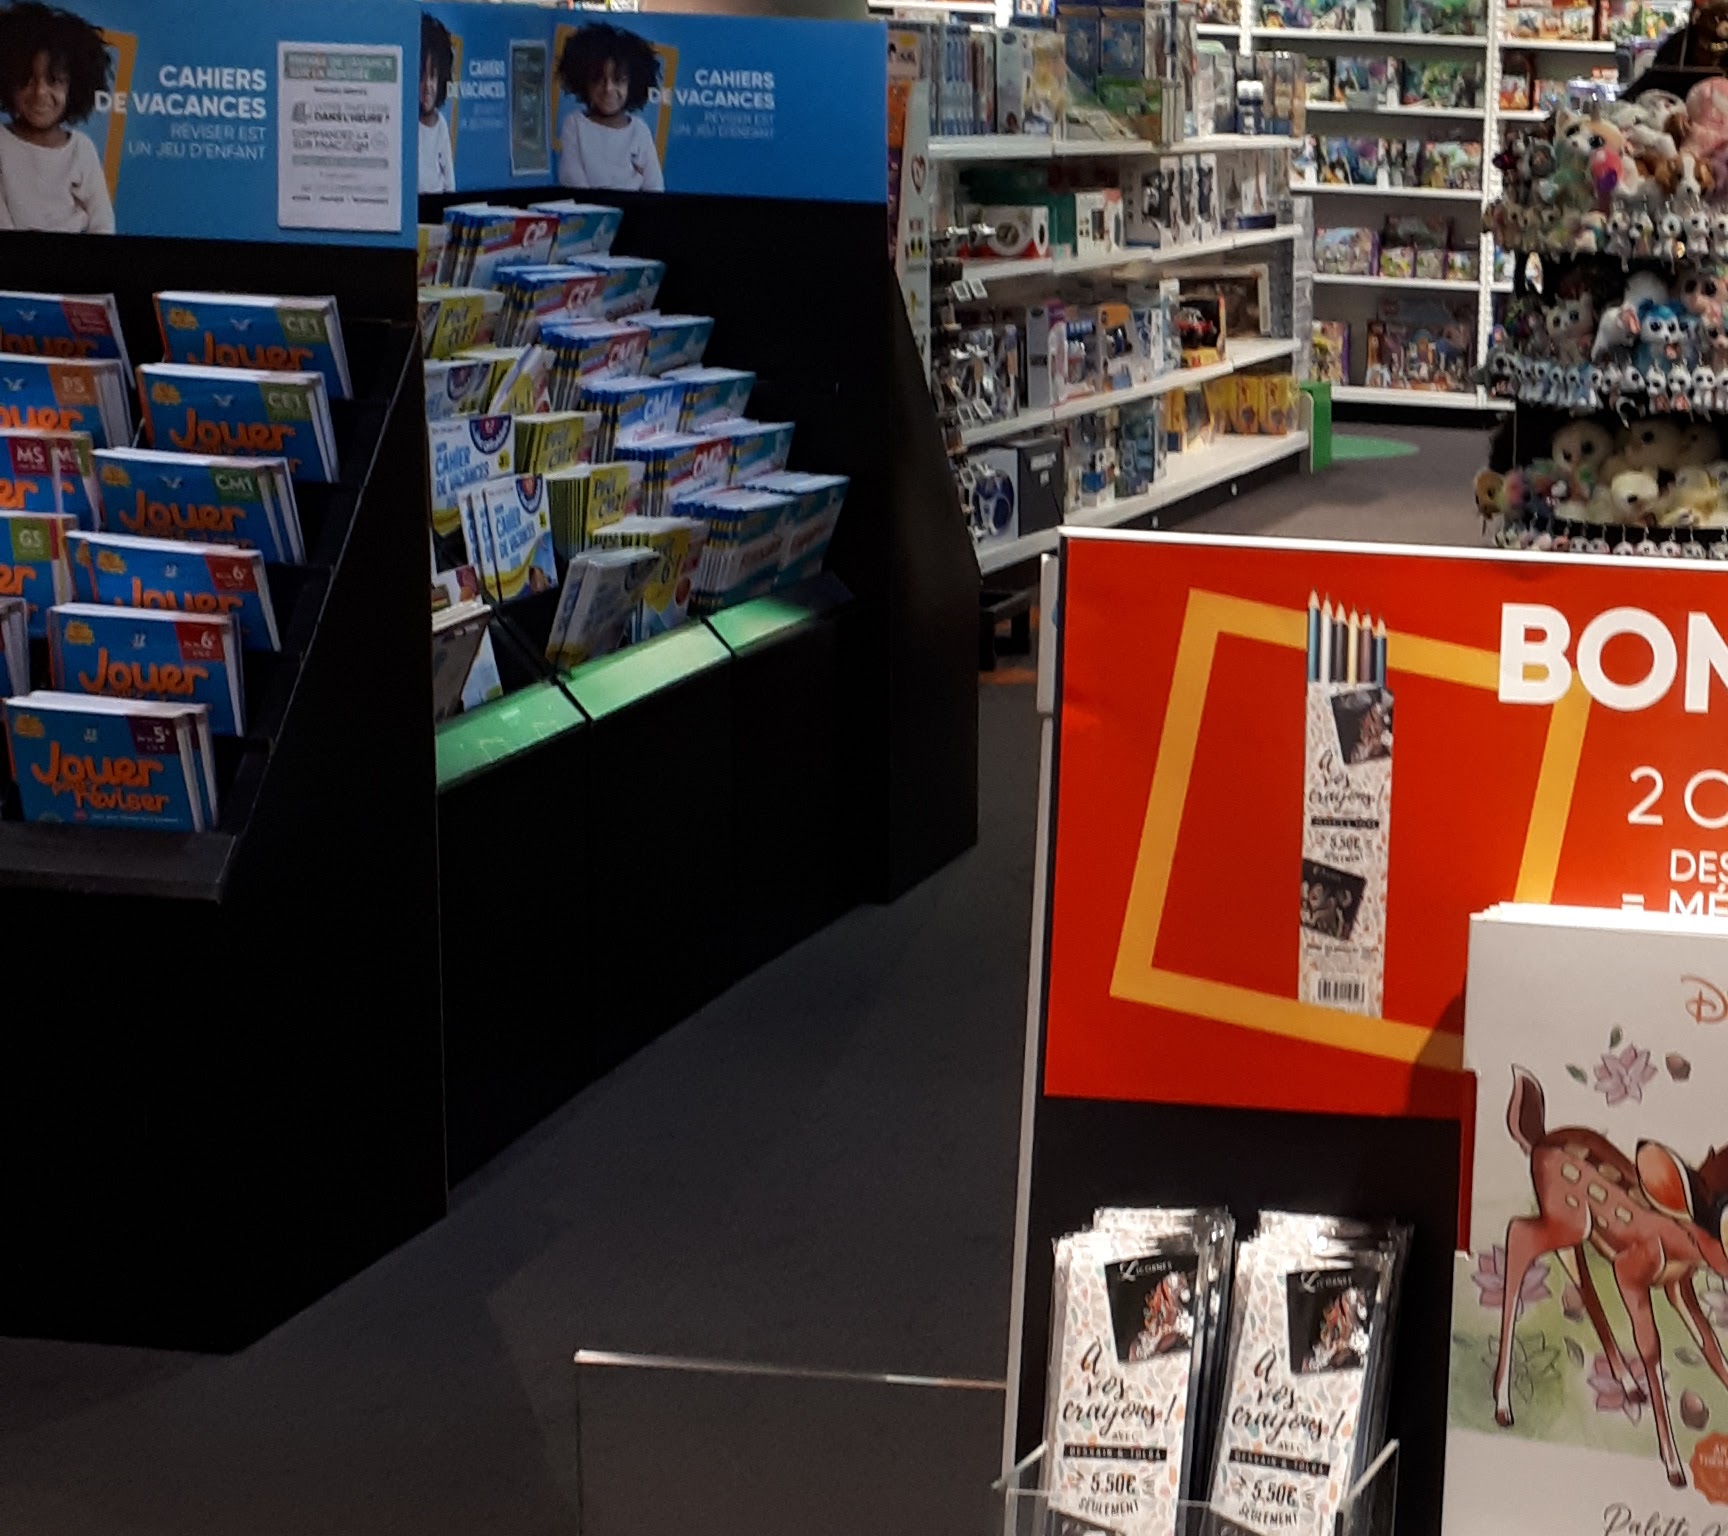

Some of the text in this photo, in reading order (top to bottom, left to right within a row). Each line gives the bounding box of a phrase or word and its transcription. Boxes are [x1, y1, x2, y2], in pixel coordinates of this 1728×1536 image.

[159, 65, 267, 92] CAHIERS
[695, 68, 775, 90] CAHIERS
[94, 90, 127, 113] DE
[131, 93, 267, 120] VACANCES
[648, 87, 775, 110] DE VACANCES
[239, 125, 266, 140] EST
[170, 408, 296, 452] Jouer
[119, 489, 247, 532] Jouer
[79, 647, 208, 694] Jouer
[31, 741, 163, 787] Jouer
[1626, 764, 1665, 828] 2
